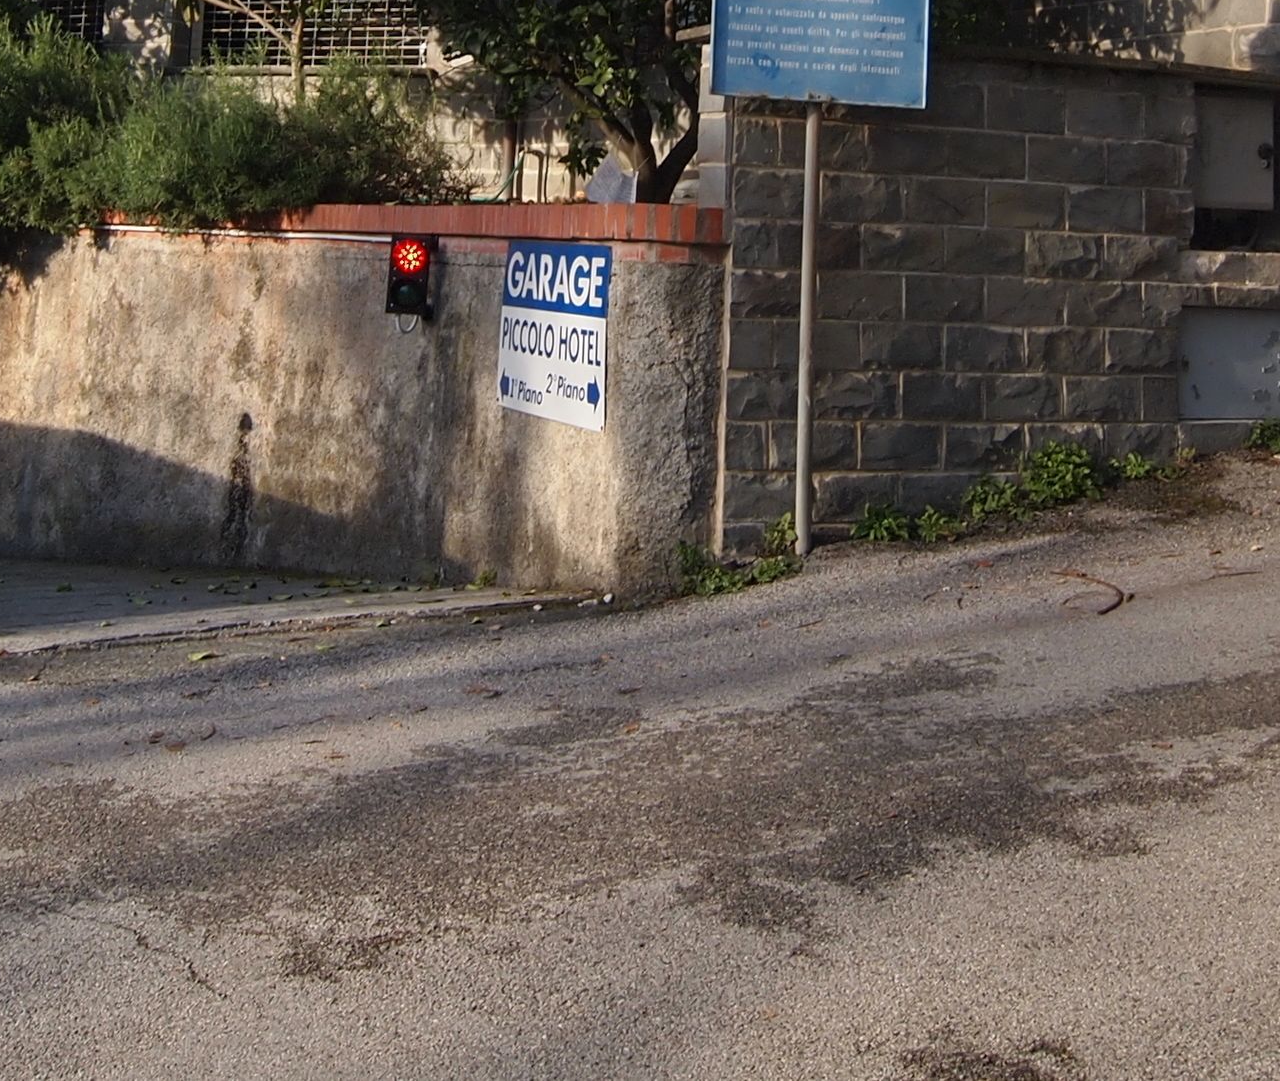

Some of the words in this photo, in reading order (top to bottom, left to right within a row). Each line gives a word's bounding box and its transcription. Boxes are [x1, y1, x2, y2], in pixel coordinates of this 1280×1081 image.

[507, 251, 606, 308] GARAGE
[502, 317, 555, 359] PICCOLO
[558, 326, 601, 367] HOTEL
[518, 381, 543, 405] Piano
[557, 376, 585, 402] Piano
